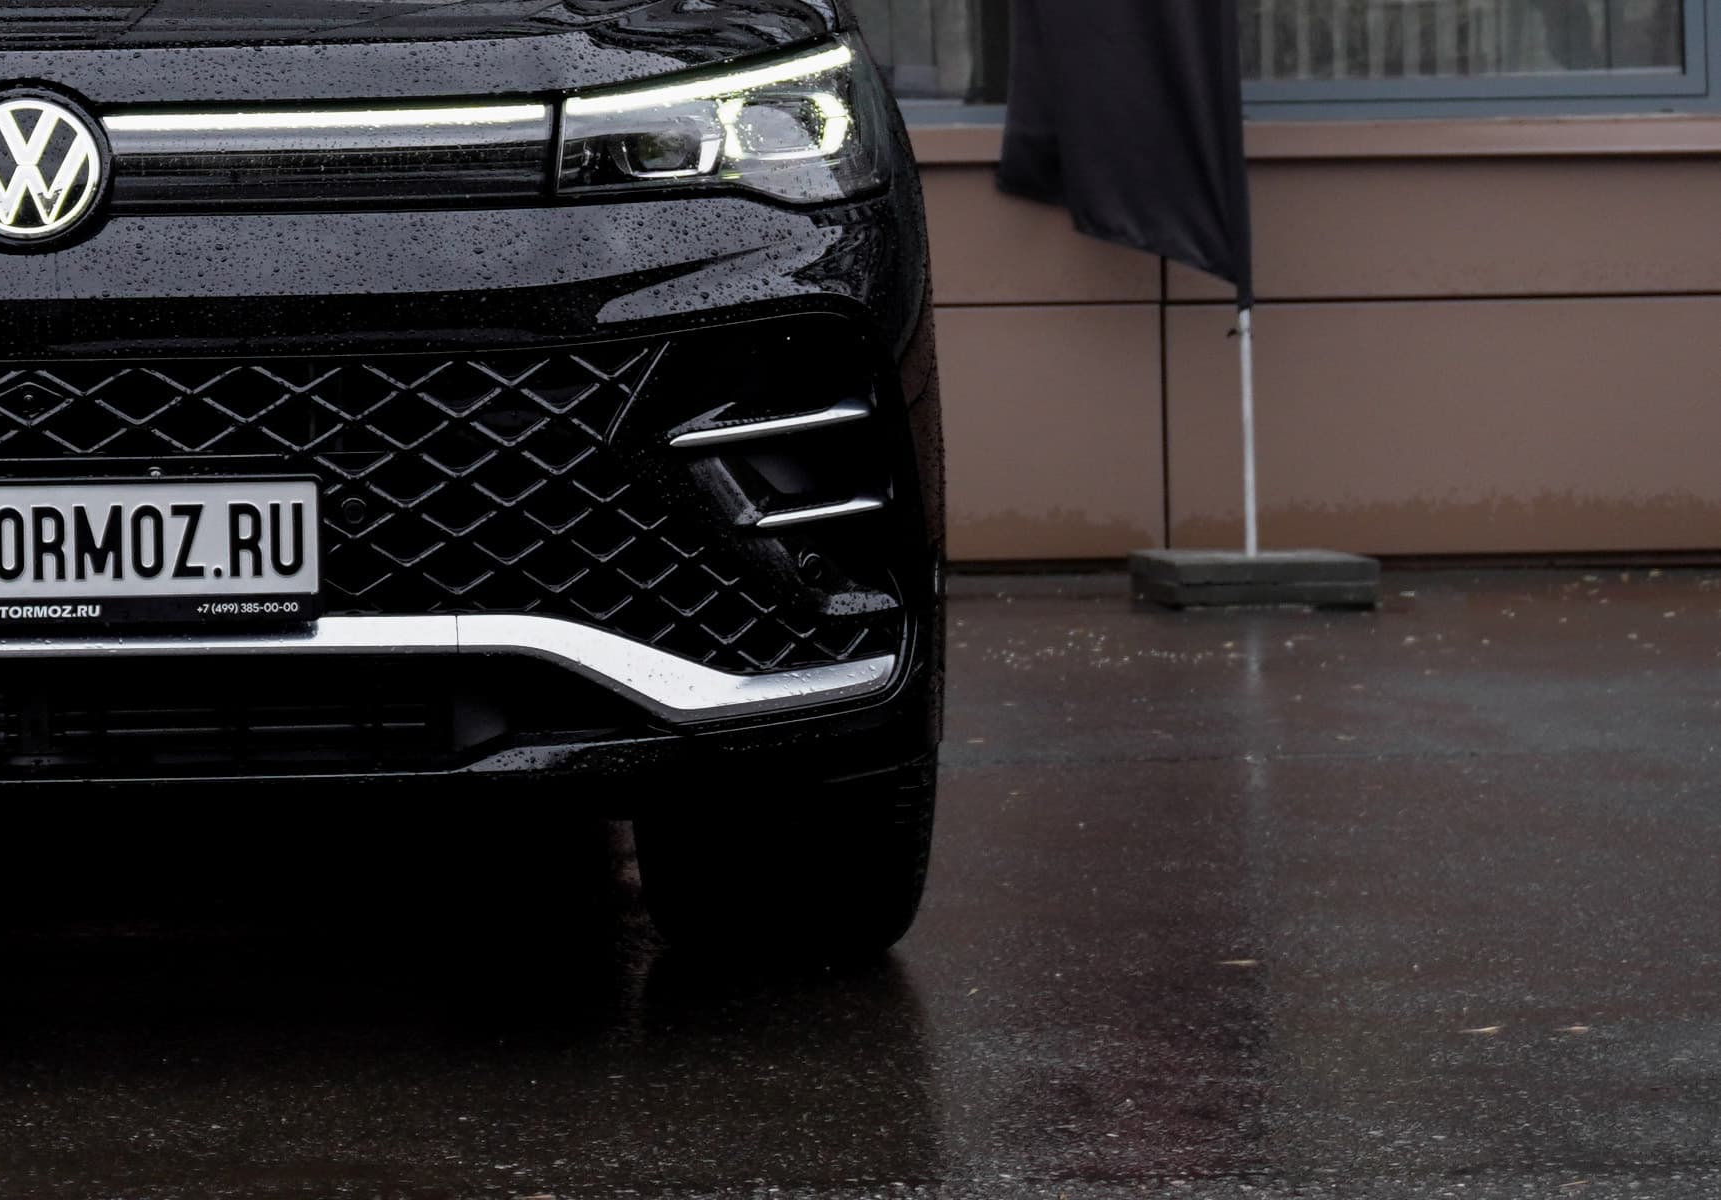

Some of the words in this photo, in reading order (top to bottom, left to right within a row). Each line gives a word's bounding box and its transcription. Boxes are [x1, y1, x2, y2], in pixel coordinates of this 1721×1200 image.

[196, 603, 209, 613] +7
[211, 603, 239, 614] (499)
[240, 602, 299, 613] 385-00-00
